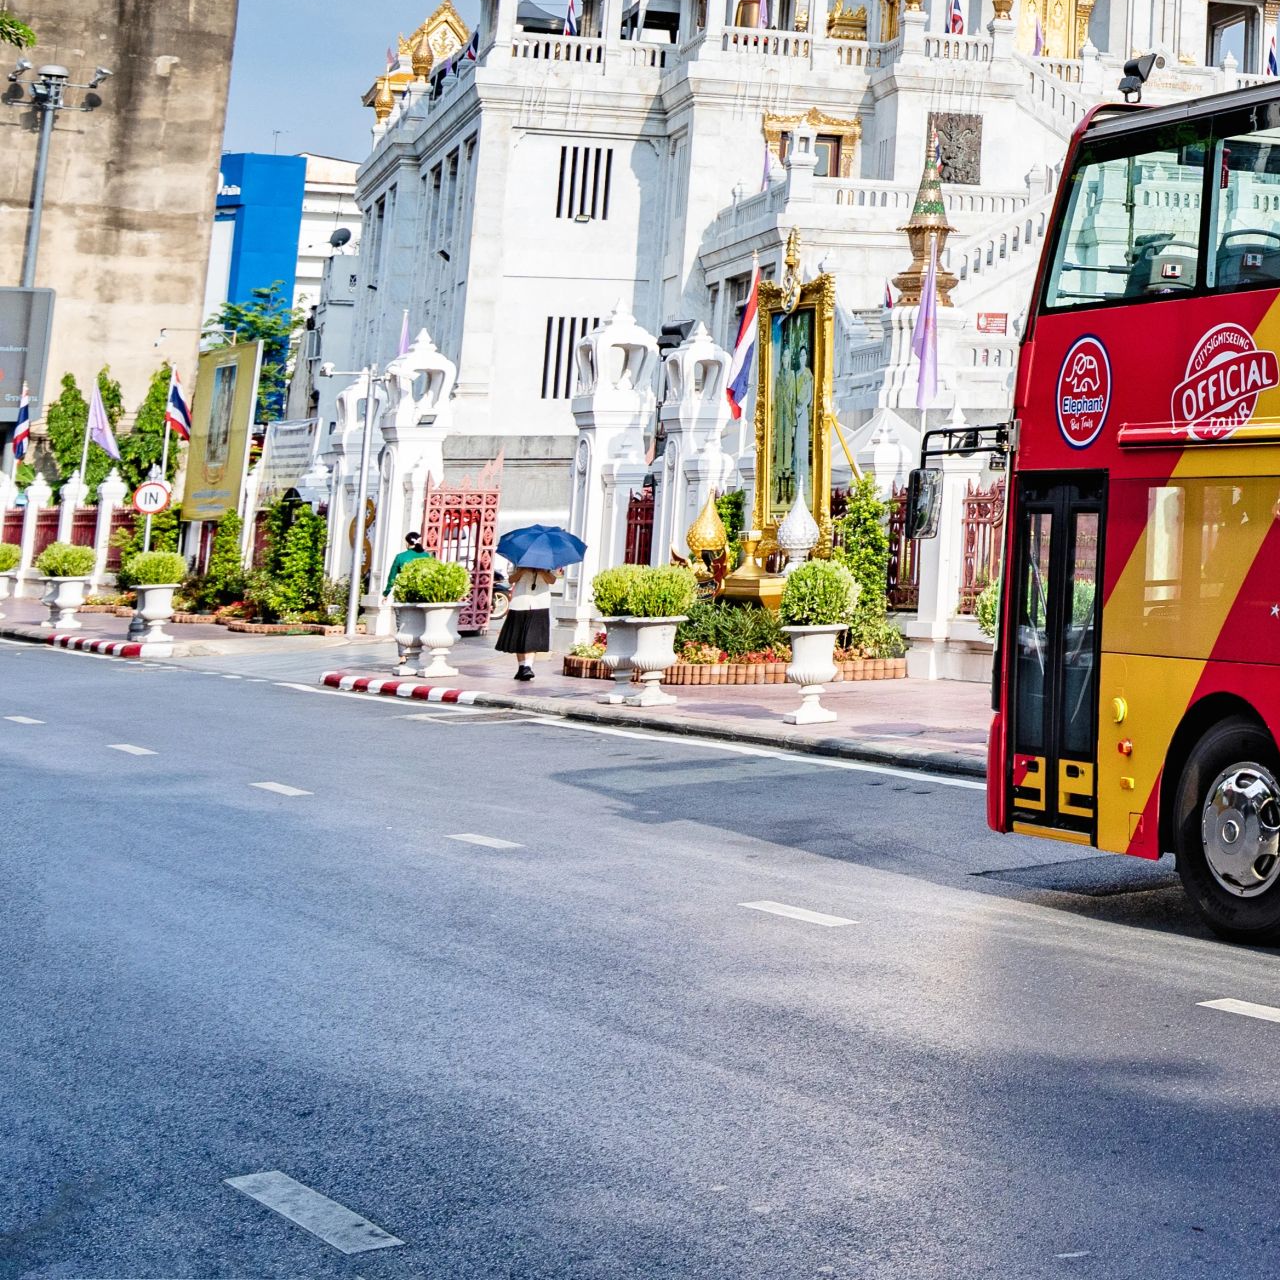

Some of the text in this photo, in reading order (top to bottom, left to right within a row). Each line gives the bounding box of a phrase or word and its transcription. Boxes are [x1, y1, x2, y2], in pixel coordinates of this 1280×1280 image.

[1194, 331, 1250, 371] CITYSIGHTSEEING
[1182, 356, 1273, 421] OFFICIAL
[1062, 395, 1104, 417] Elephant
[1204, 402, 1251, 435] TOUR
[1070, 418, 1080, 431] Bus
[144, 492, 159, 505] IN
